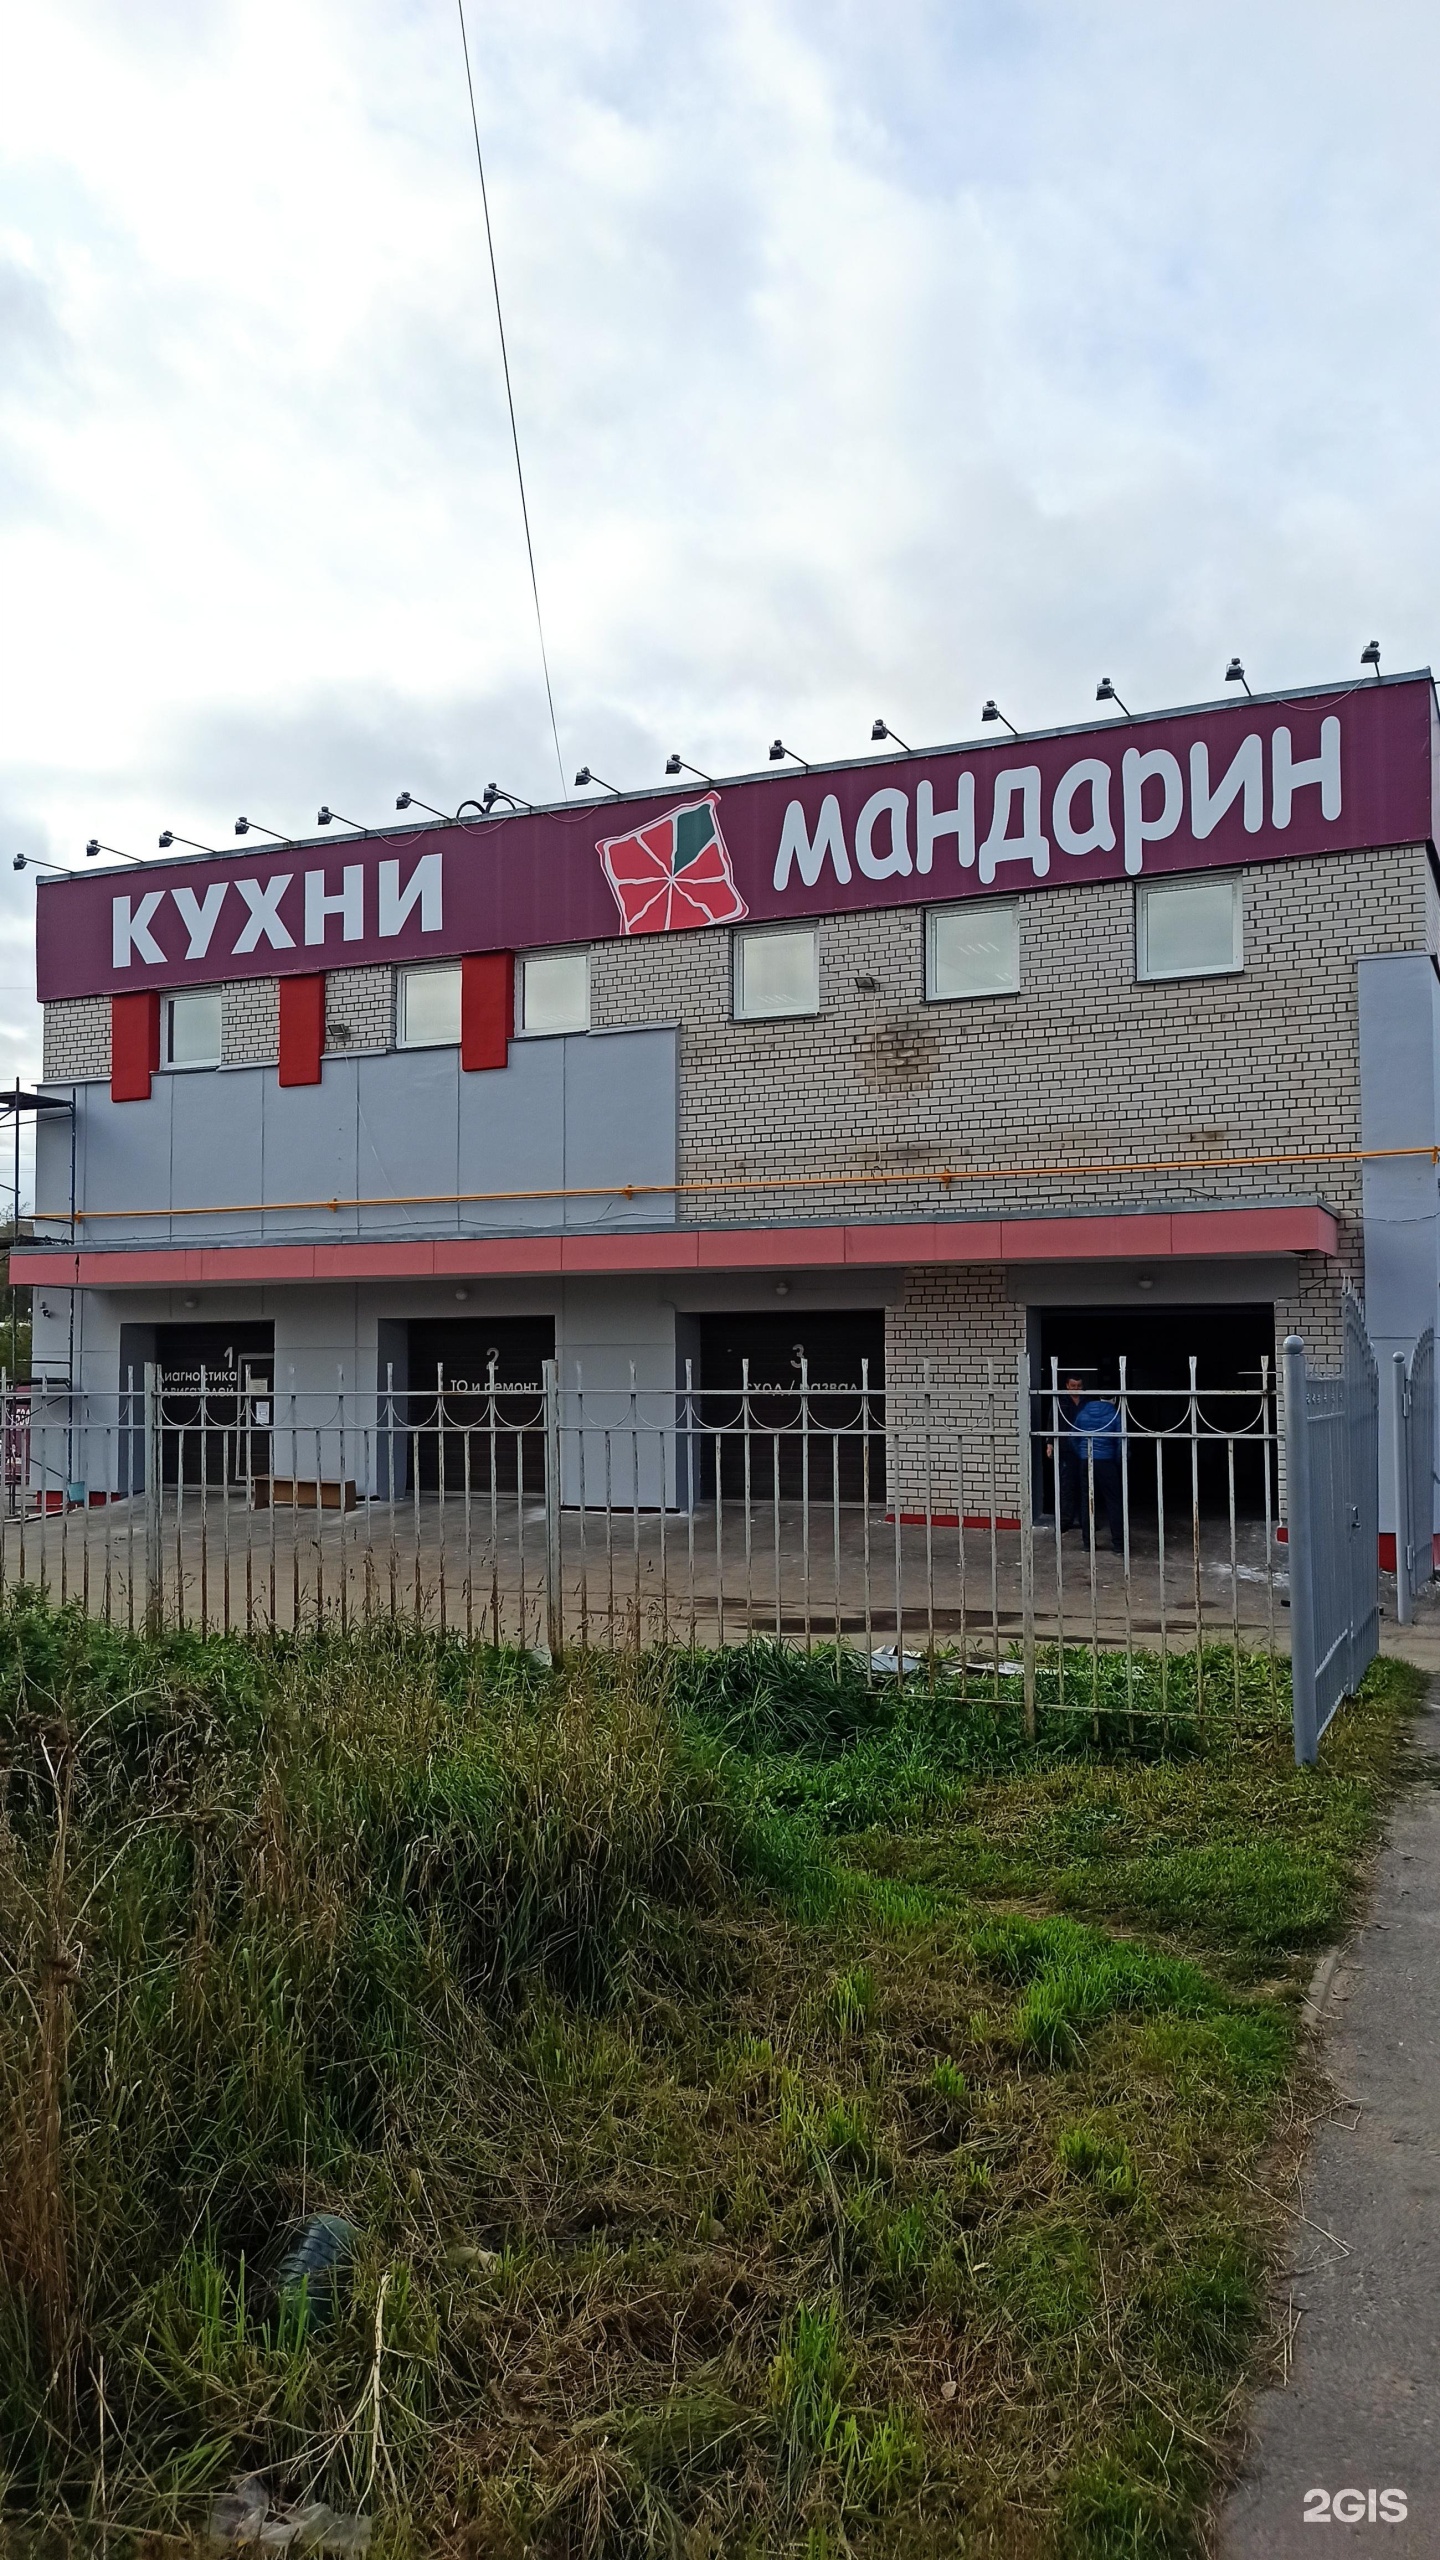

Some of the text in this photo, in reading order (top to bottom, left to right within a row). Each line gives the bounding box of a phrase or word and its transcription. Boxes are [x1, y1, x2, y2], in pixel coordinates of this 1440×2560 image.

[112, 715, 1342, 969] КУХНИ мандарин
[223, 1346, 233, 1369] 1
[486, 1347, 500, 1370] 2
[790, 1343, 805, 1369] 3
[161, 1371, 238, 1383] иагностика
[450, 1379, 468, 1392] ТО
